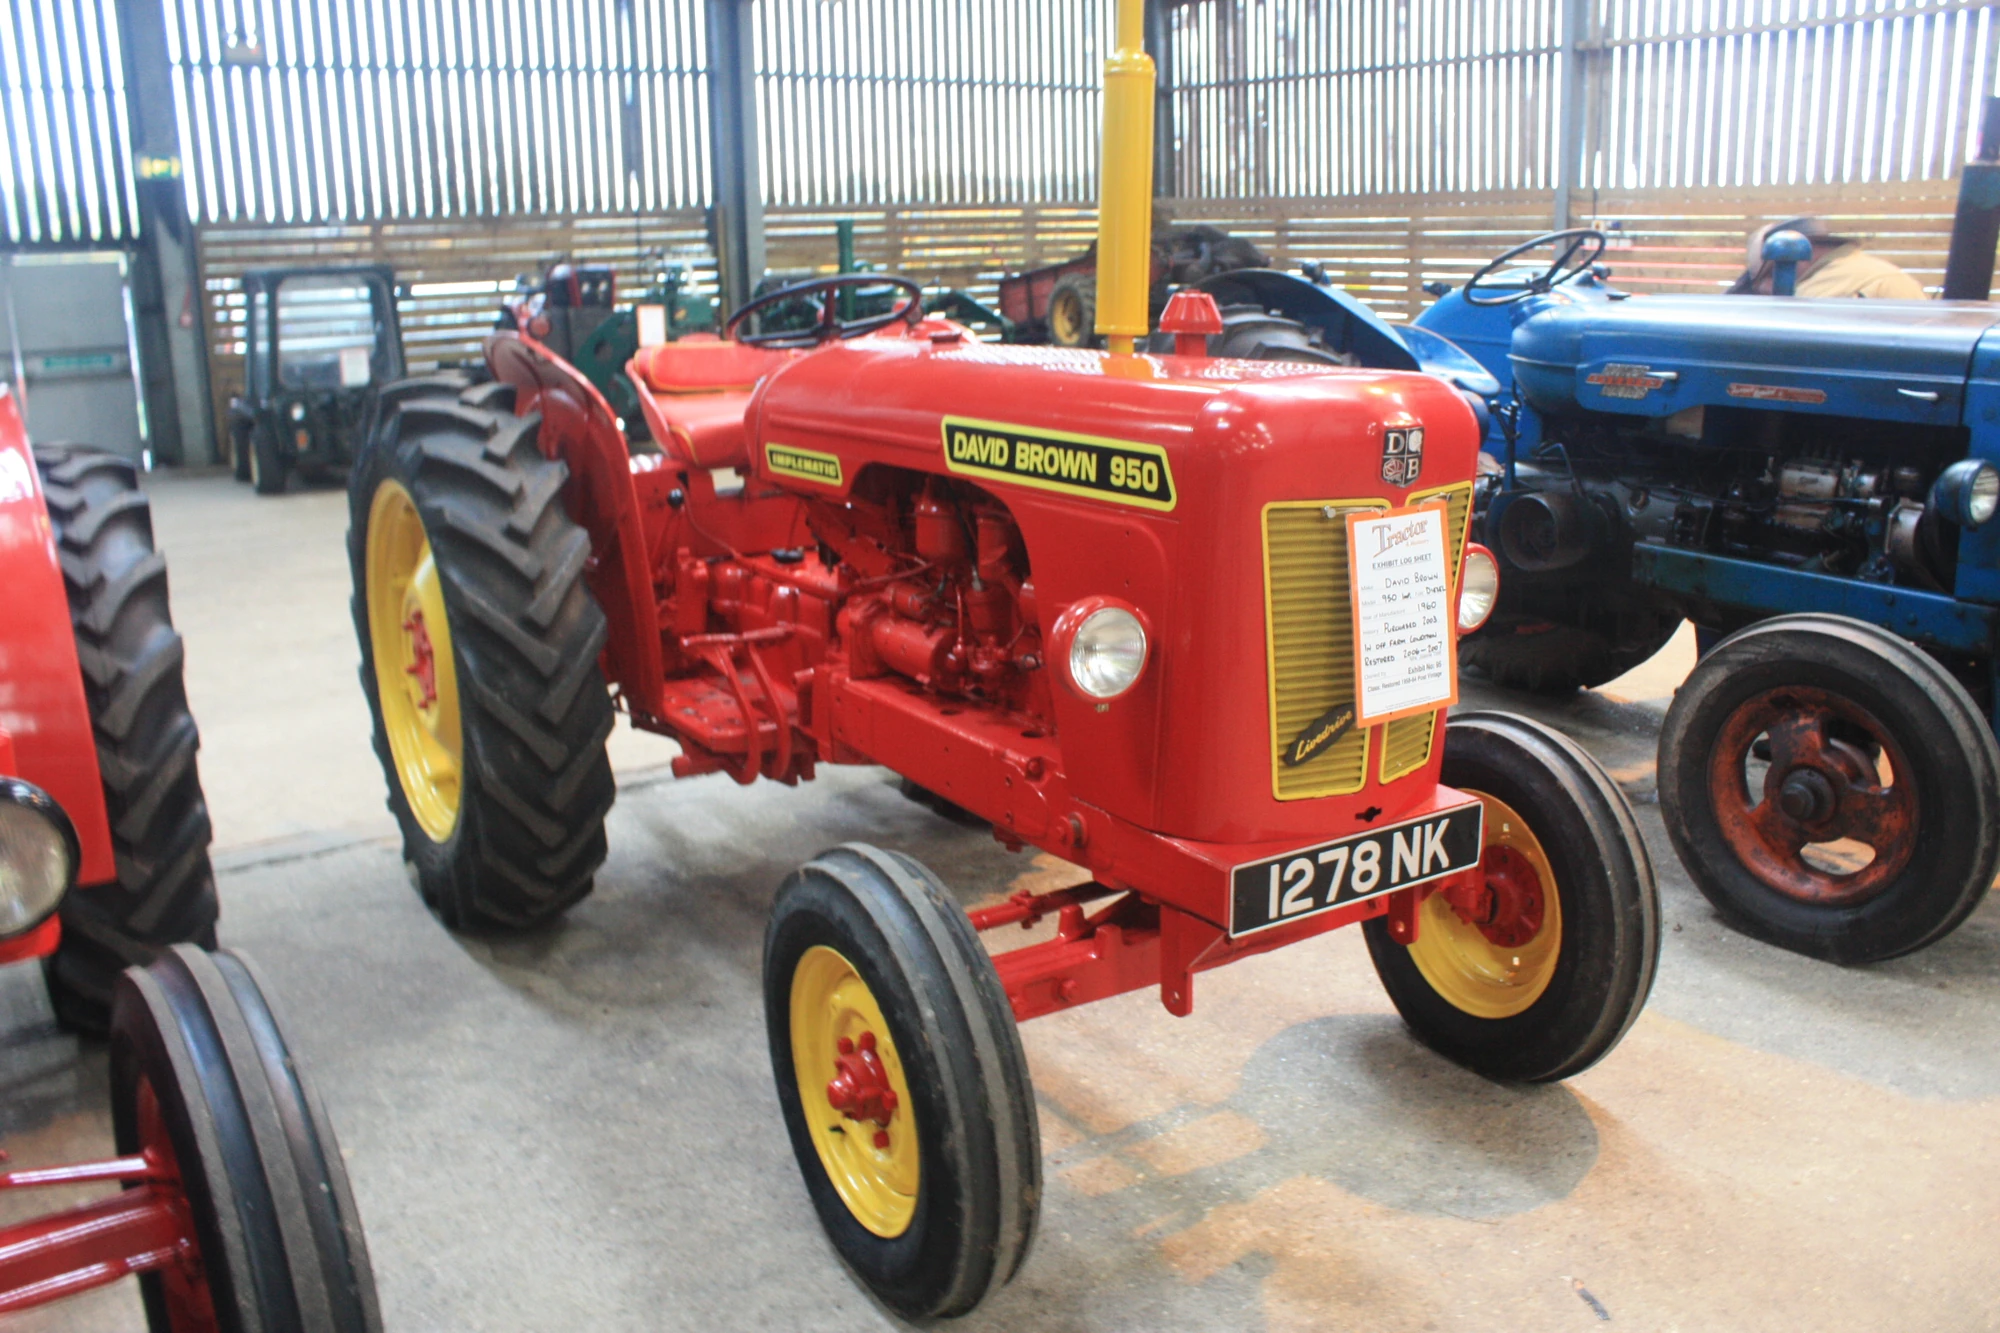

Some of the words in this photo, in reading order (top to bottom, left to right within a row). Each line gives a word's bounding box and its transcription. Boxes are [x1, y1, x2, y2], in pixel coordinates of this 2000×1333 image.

[771, 451, 838, 477] IMPLEMATIC
[953, 431, 1009, 467] DAVID
[1015, 441, 1097, 483] BROWN
[1110, 455, 1159, 493] 950
[1371, 520, 1428, 558] Tractor
[1372, 559, 1398, 570] EXHIBIT
[1400, 557, 1412, 566] LOG
[1414, 553, 1432, 563] SHEET
[1382, 593, 1397, 603] 950
[1417, 601, 1437, 612] 1960
[1422, 615, 1438, 626] 2003
[1295, 710, 1353, 762] Livedrive
[1268, 840, 1382, 920] 1278
[1390, 818, 1450, 884] NK
